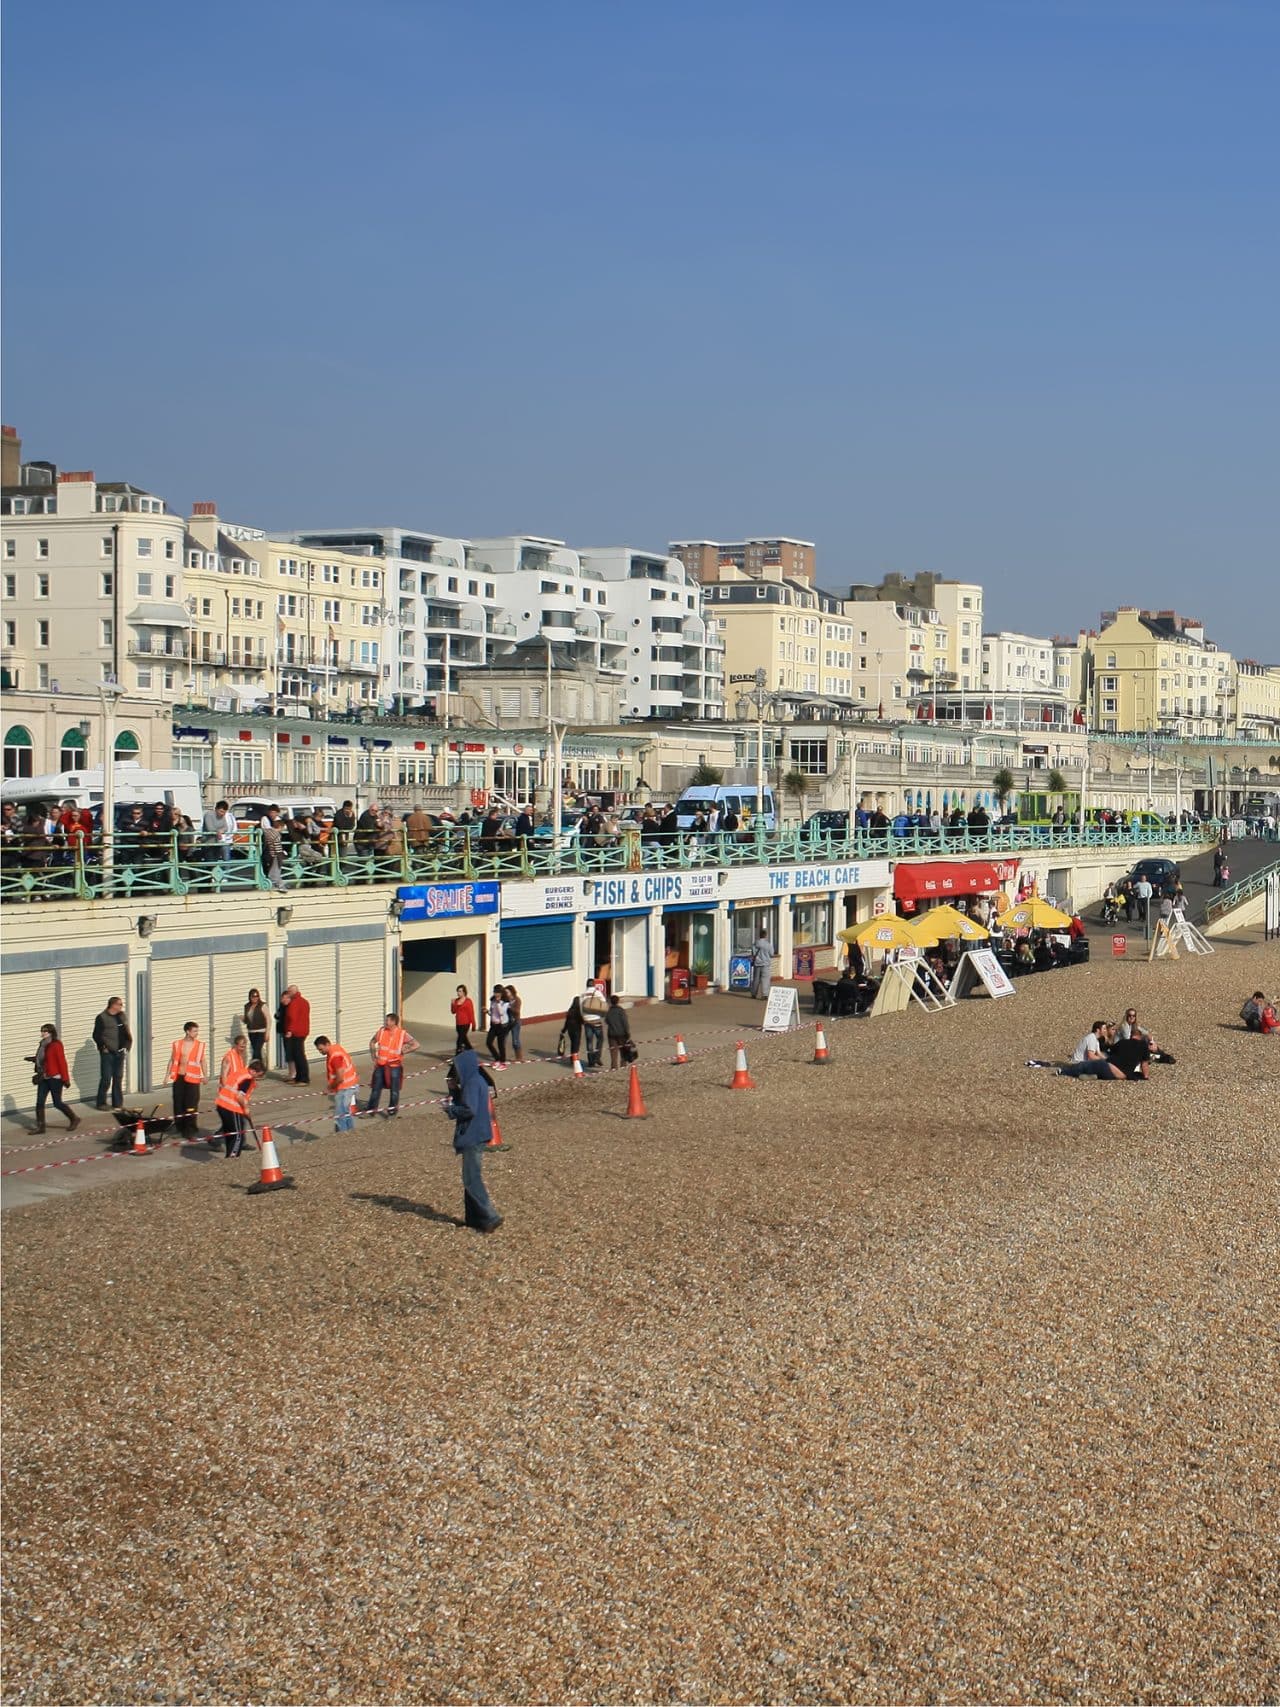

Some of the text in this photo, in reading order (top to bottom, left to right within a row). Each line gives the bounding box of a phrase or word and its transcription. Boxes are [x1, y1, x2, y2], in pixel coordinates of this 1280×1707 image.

[769, 866, 860, 889] THE BEACH CAFE
[545, 886, 575, 894] BURGERS
[593, 876, 682, 906] FISH & CHIPS
[545, 901, 574, 910] DRINKS
